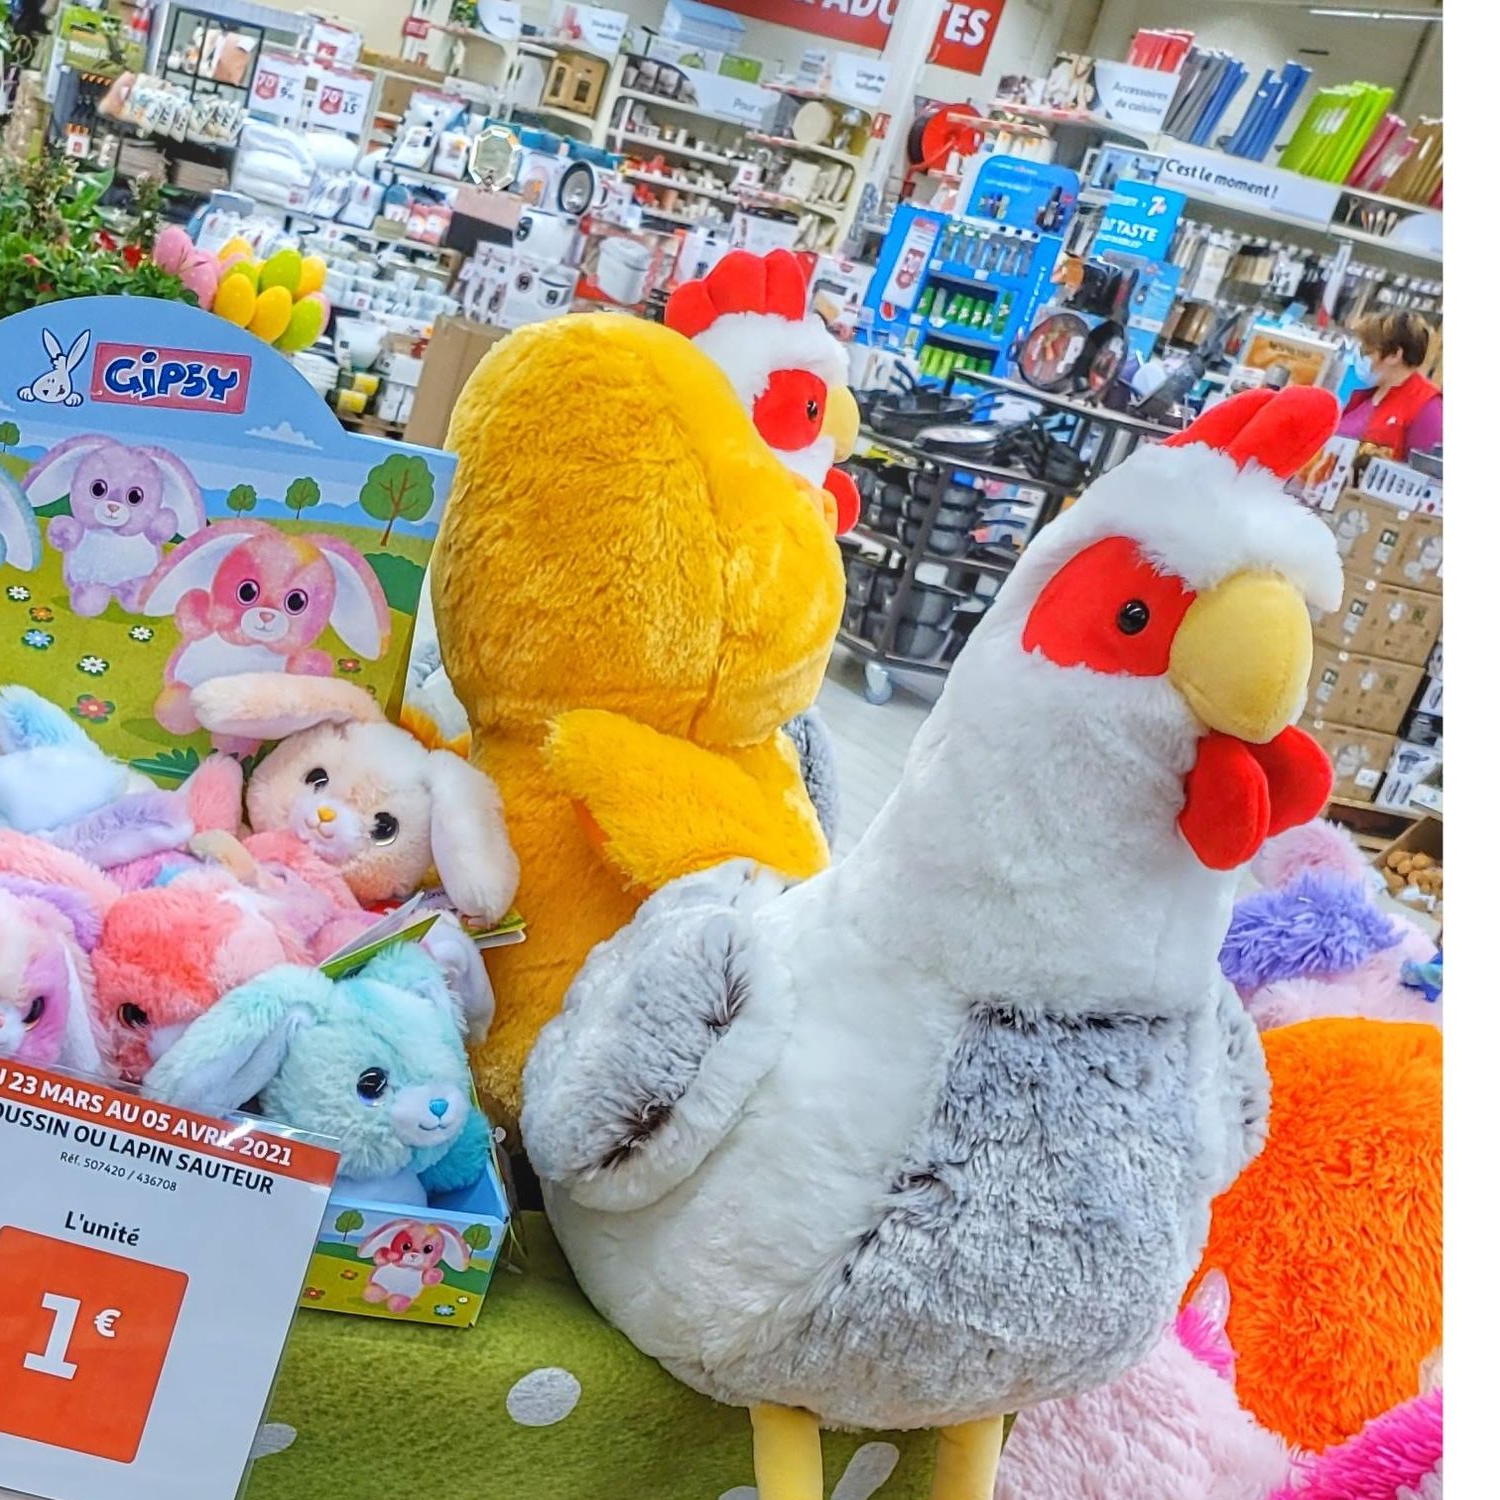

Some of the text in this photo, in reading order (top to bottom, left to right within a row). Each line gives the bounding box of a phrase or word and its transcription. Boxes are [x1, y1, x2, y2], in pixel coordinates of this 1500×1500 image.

[1112, 81, 1169, 100] Accessoires
[1128, 101, 1163, 115] cuisine
[1165, 159, 1197, 177] C'est
[1199, 166, 1211, 182] le
[1214, 174, 1270, 196] moment
[1117, 219, 1159, 242] TASTE
[8, 1072, 38, 1095] 23
[40, 1080, 104, 1113] MARS
[105, 1100, 140, 1123] AU
[142, 1110, 171, 1132] 05
[239, 1136, 292, 1167] 2021
[60, 1151, 81, 1166] Réf.
[84, 1158, 126, 1178] 507420
[136, 1173, 177, 1192] 436708
[74, 1125, 106, 1147] OU
[109, 1134, 174, 1167] LAPIN
[176, 1153, 274, 1195] SAUTEUR
[65, 1210, 141, 1246] L'unité
